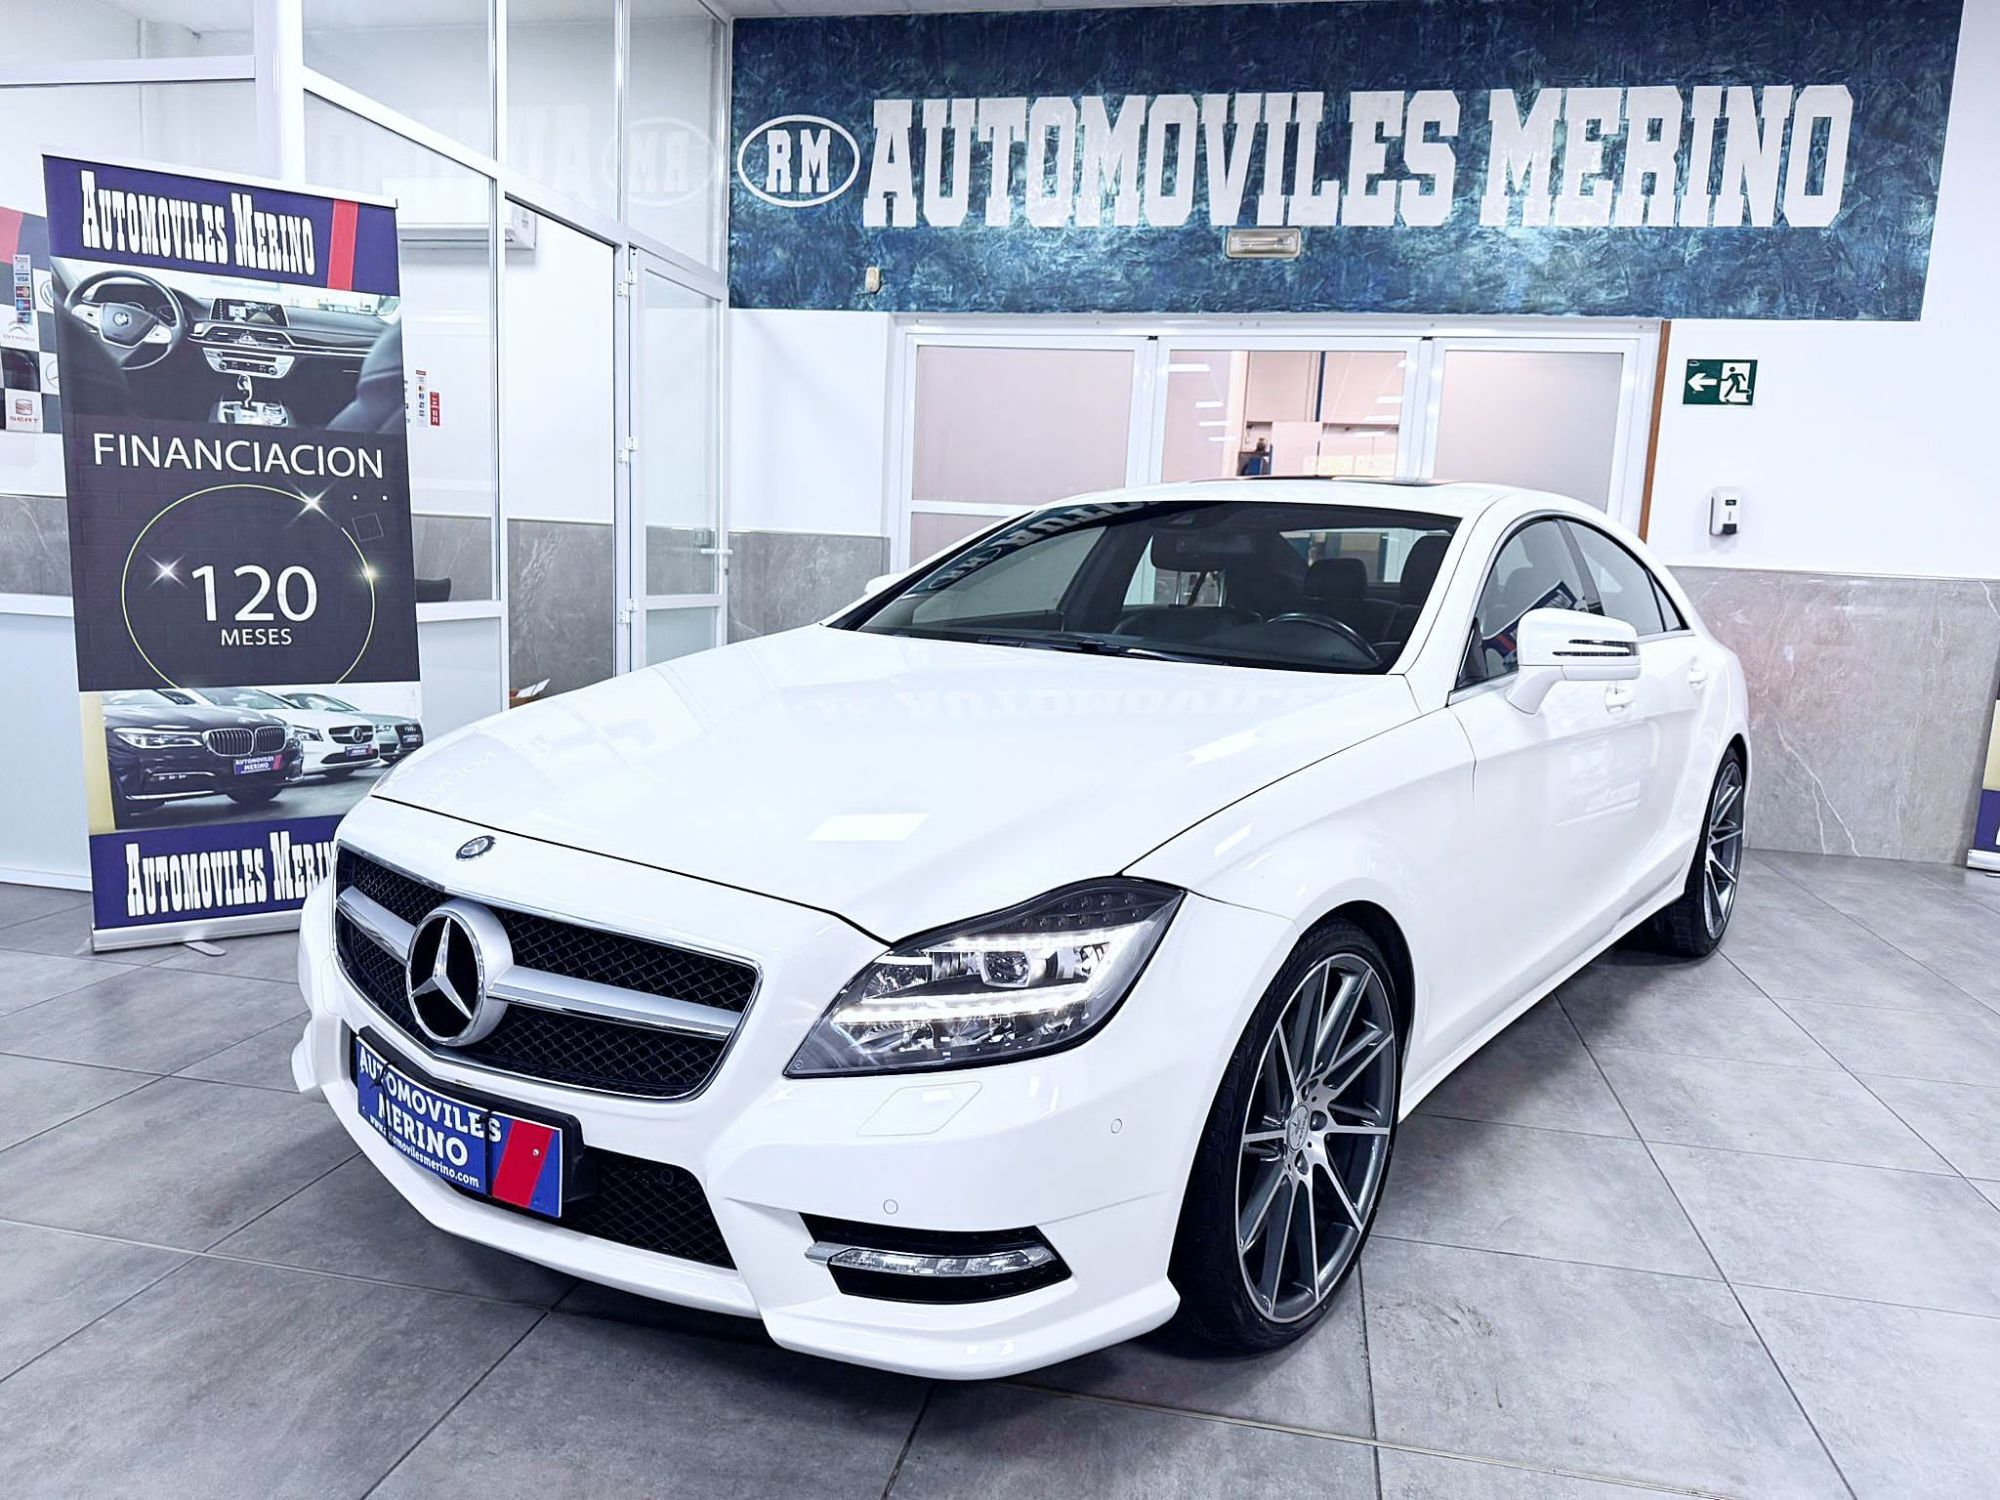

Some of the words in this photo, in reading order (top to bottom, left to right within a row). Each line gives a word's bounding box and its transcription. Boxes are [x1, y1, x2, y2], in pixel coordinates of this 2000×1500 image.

[765, 129, 831, 193] RM
[863, 89, 1461, 228] AUTOMOVILES
[1479, 84, 1854, 228] MERINO
[80, 169, 229, 266] AUTOMOVILES
[230, 192, 316, 277] MERINO
[92, 432, 384, 479] FINANCIACION
[191, 564, 318, 622] 120
[221, 628, 293, 646] MESES
[125, 843, 268, 917] AUTOMOVILES
[378, 1092, 468, 1167] MERINO
